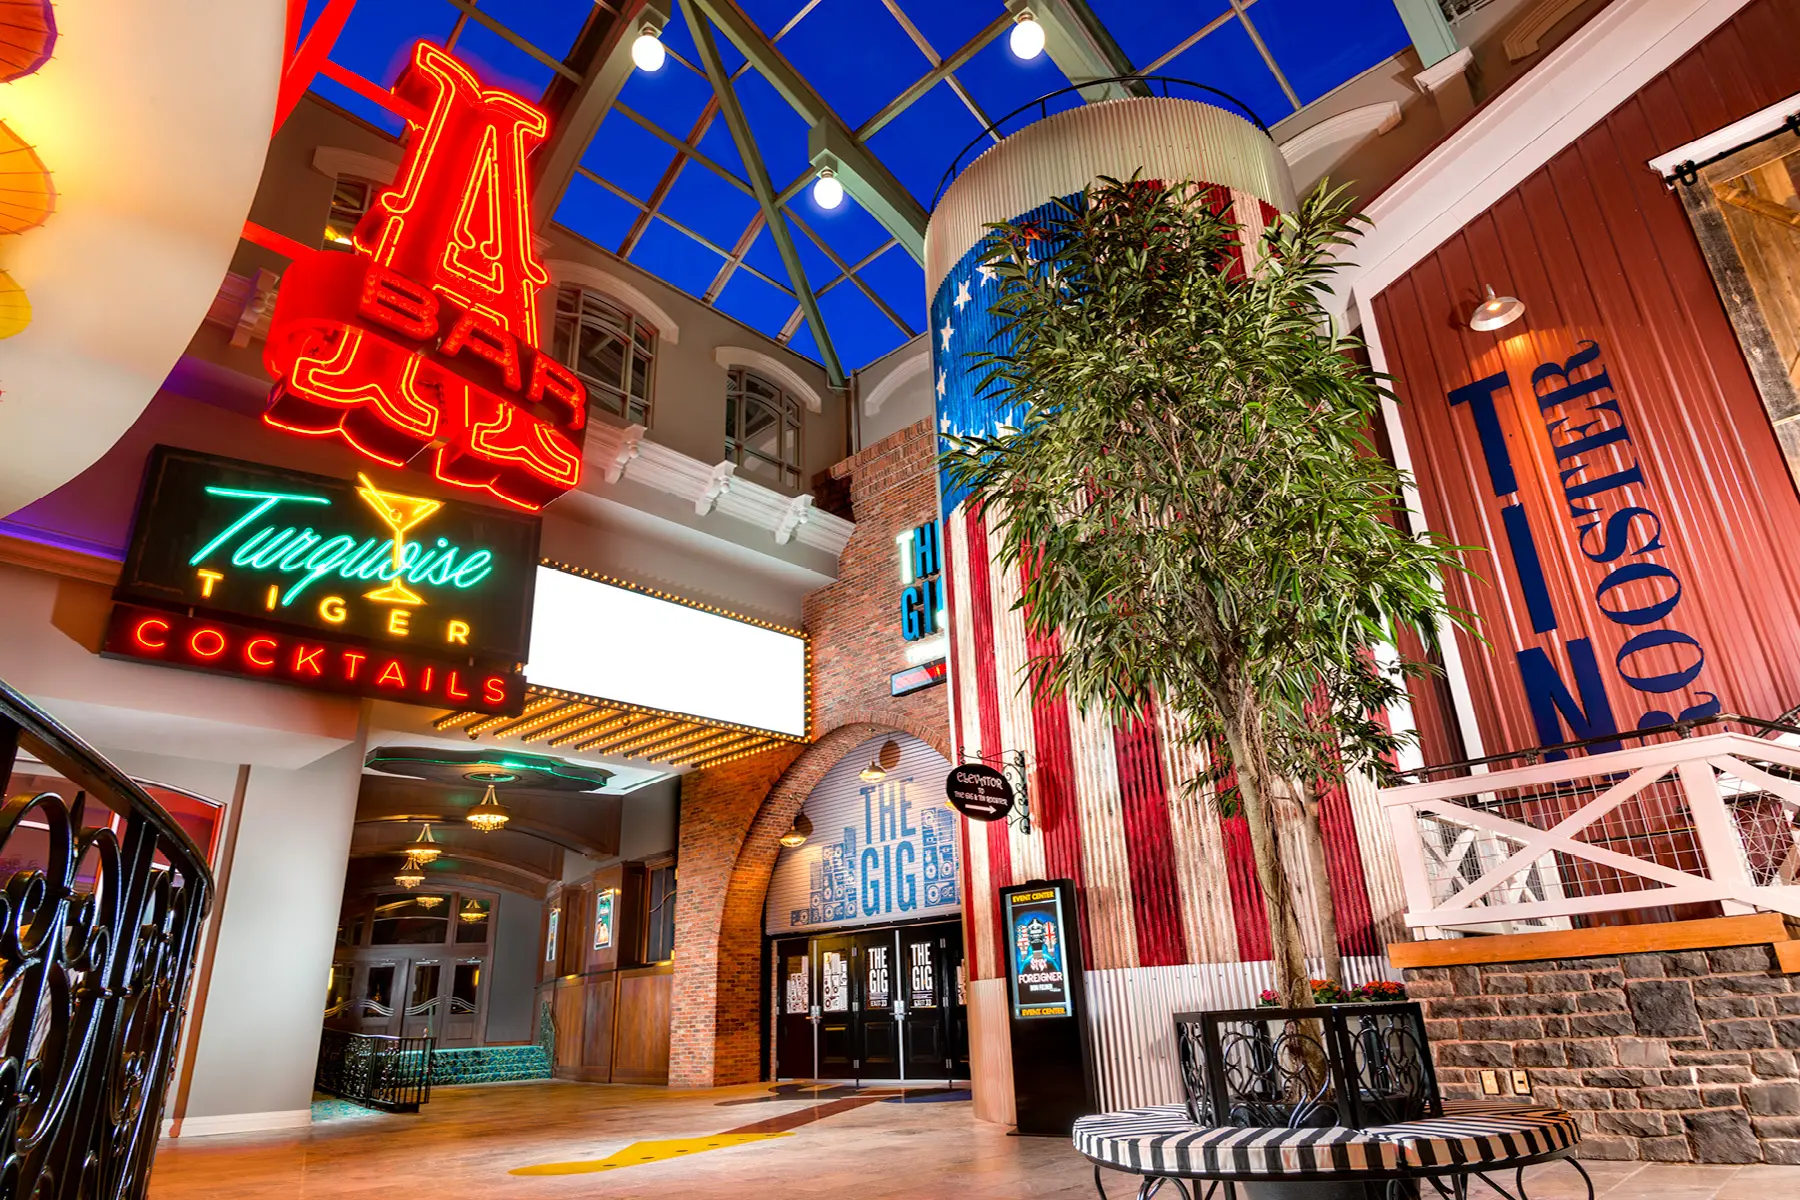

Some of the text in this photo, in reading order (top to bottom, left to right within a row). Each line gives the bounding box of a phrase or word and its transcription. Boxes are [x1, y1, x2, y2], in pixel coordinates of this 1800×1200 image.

[288, 40, 582, 490] A
[358, 268, 586, 431] BAR
[189, 486, 492, 606] Turquoise
[1447, 370, 1626, 775] TIN
[197, 568, 472, 645] TIGER
[135, 618, 506, 702] COCKTAILS
[859, 777, 917, 844] THE
[860, 841, 917, 917] GIG
[1012, 891, 1054, 903] EVENT CENTER
[868, 947, 888, 970] THE
[869, 968, 888, 993] GIG
[910, 943, 932, 966] THE
[912, 965, 933, 991] GIG
[1018, 971, 1063, 984] FOREIGNER
[1022, 1007, 1065, 1016] EVENT CENTER
